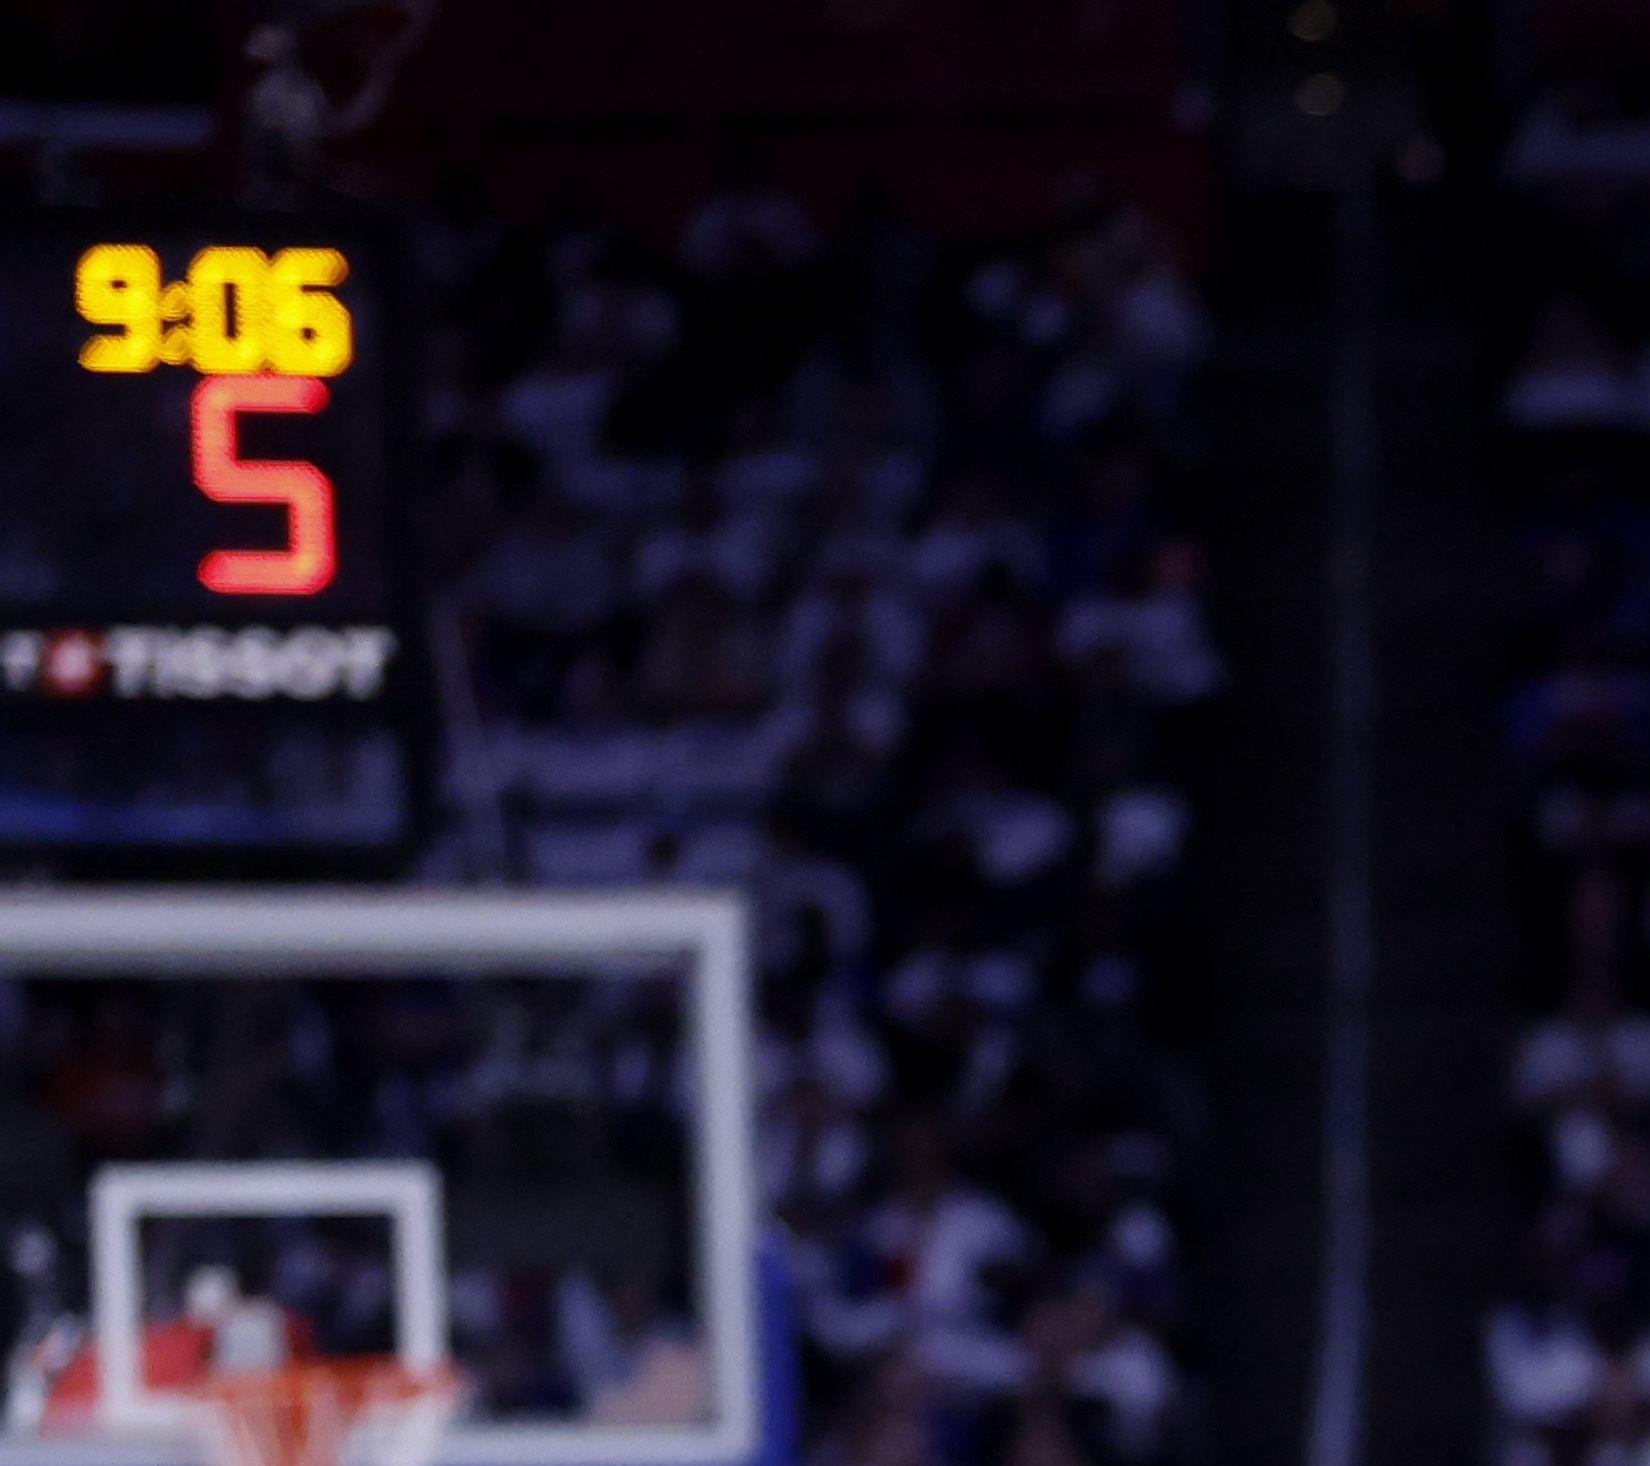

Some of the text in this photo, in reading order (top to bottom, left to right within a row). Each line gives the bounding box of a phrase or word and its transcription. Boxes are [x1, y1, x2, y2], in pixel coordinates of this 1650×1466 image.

[75, 243, 355, 376] 9:06
[190, 374, 336, 593] 5
[106, 624, 396, 699] TISSOT
